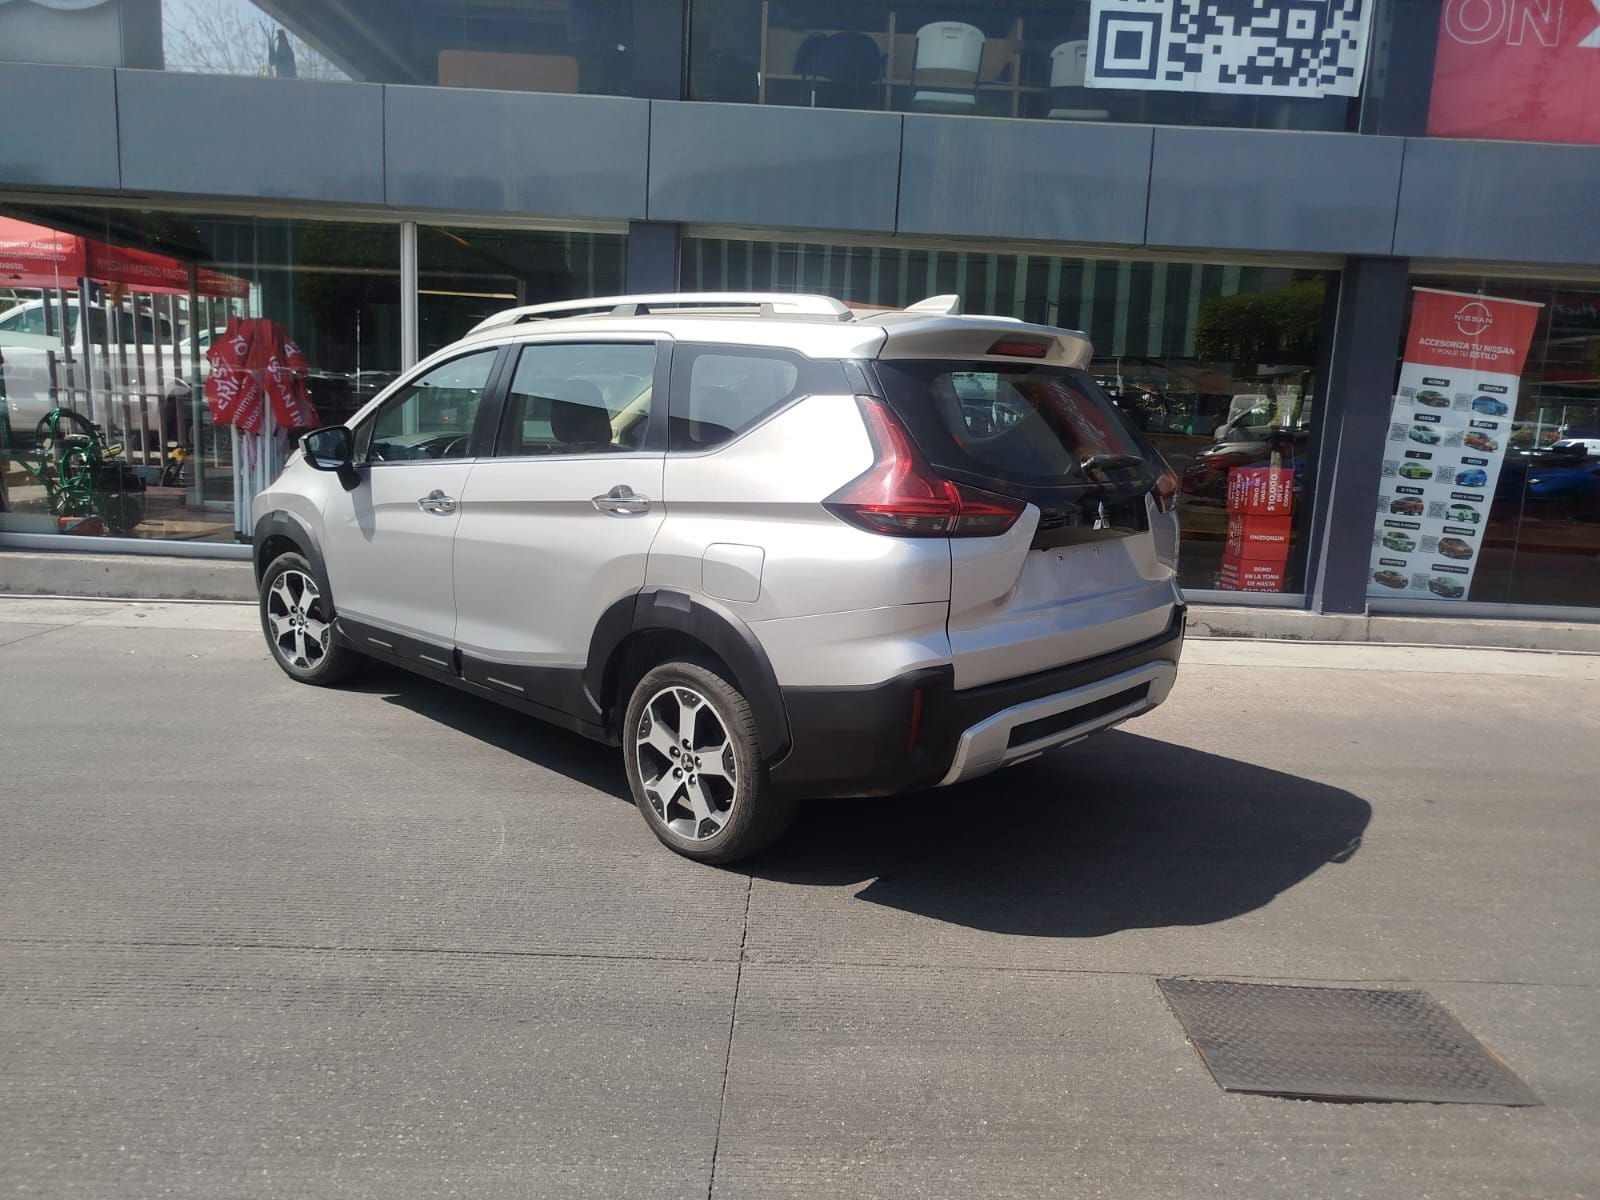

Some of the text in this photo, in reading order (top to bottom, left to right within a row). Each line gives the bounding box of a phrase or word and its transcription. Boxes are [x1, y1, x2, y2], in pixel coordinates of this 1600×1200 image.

[1454, 314, 1493, 324] NISSAN
[1418, 337, 1516, 356] ACCESORIZA TU NISSAN
[1459, 350, 1469, 358] TU
[1469, 351, 1498, 361] ESTILO
